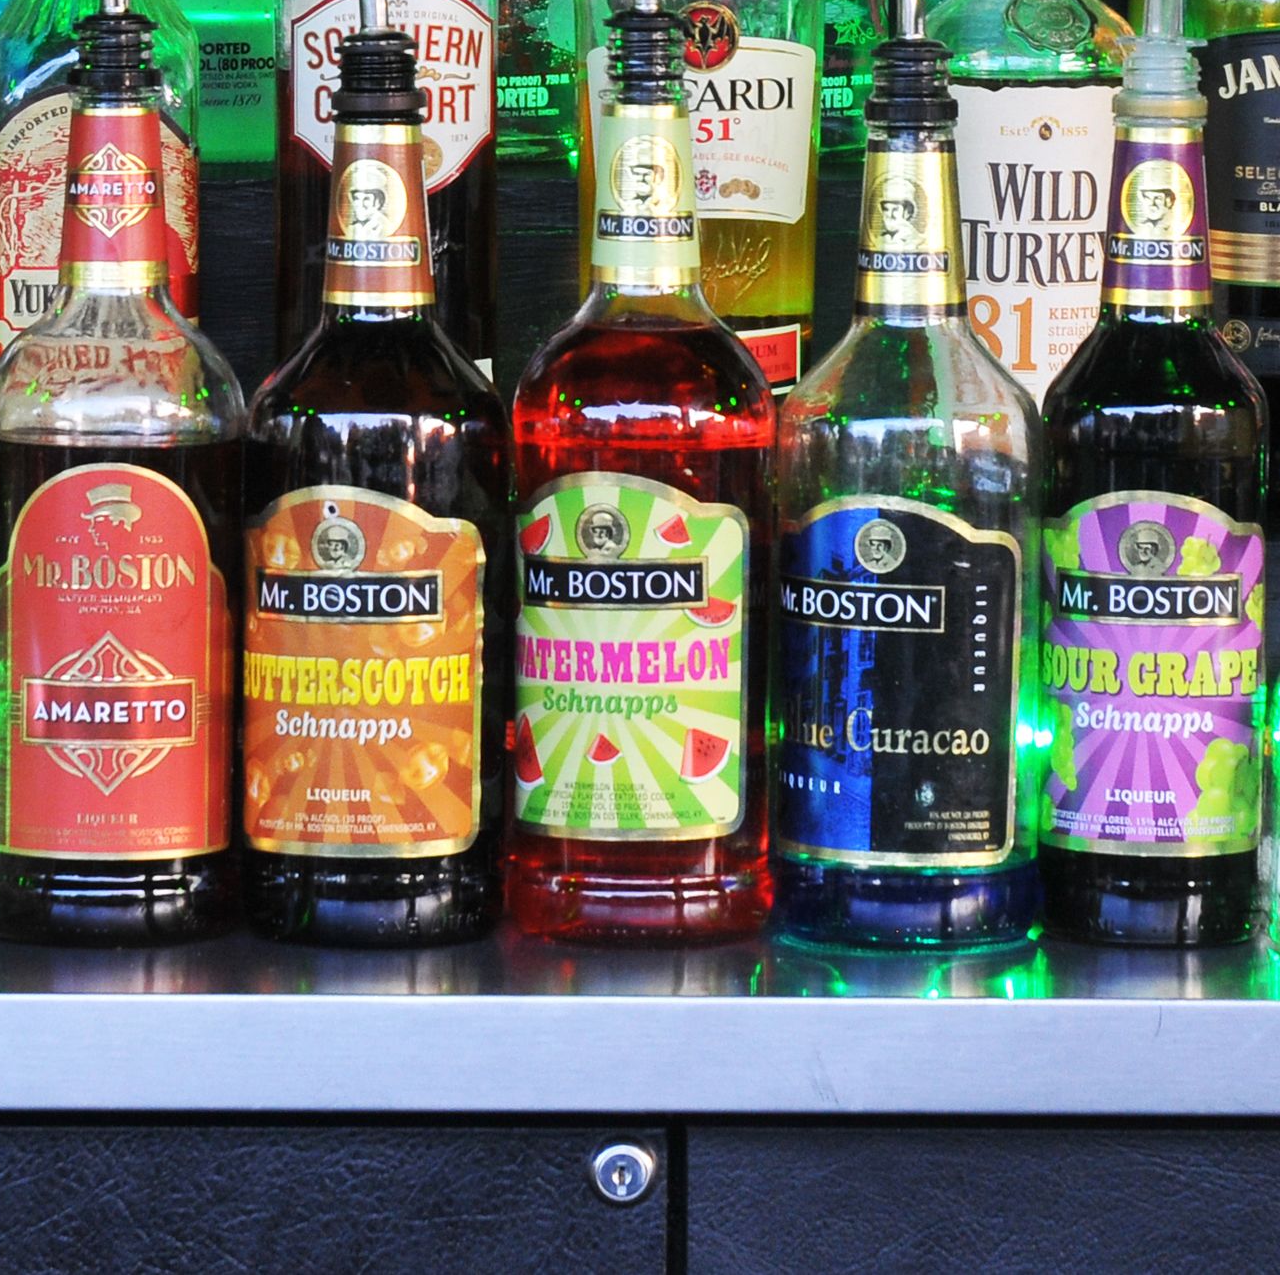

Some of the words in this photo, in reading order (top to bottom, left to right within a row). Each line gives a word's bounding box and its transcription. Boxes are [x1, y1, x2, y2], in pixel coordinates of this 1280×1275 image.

[334, 13, 356, 22] NEW
[413, 10, 459, 22] ORIGINAL
[7, 105, 69, 151] IMPORTED
[1061, 126, 1088, 137] 1855
[70, 181, 155, 196] AMARETTO
[988, 162, 1098, 223] WILD
[598, 219, 620, 234] Mr.
[622, 219, 691, 235] BOSTON
[344, 242, 415, 260] BOSTON
[873, 253, 945, 271] BOSTON
[1110, 240, 1130, 256] Mr.
[1134, 240, 1202, 259] BOSTON
[968, 295, 1037, 372] 81
[71, 553, 195, 590] BOSTON
[528, 568, 560, 597] Mr.
[568, 570, 696, 600] BOSTON
[260, 581, 295, 609] Mr.
[303, 583, 432, 613] BOSTON
[781, 583, 798, 612] Mr.
[802, 587, 930, 624] BOSTON
[1061, 582, 1098, 612] Mr.
[1109, 585, 1233, 615] BOSTON
[972, 585, 988, 692] LIQUEUR
[1043, 642, 1121, 695] SOUR
[1127, 648, 1257, 697] GRAPE
[33, 699, 186, 724] AMARETTO
[543, 685, 678, 720] Schnapps
[275, 709, 412, 745] Schnapps
[846, 707, 990, 754] Curacao
[1075, 702, 1214, 738] Schnapps
[306, 788, 371, 802] LIQUEUR
[1105, 789, 1176, 804] LIQUEUR
